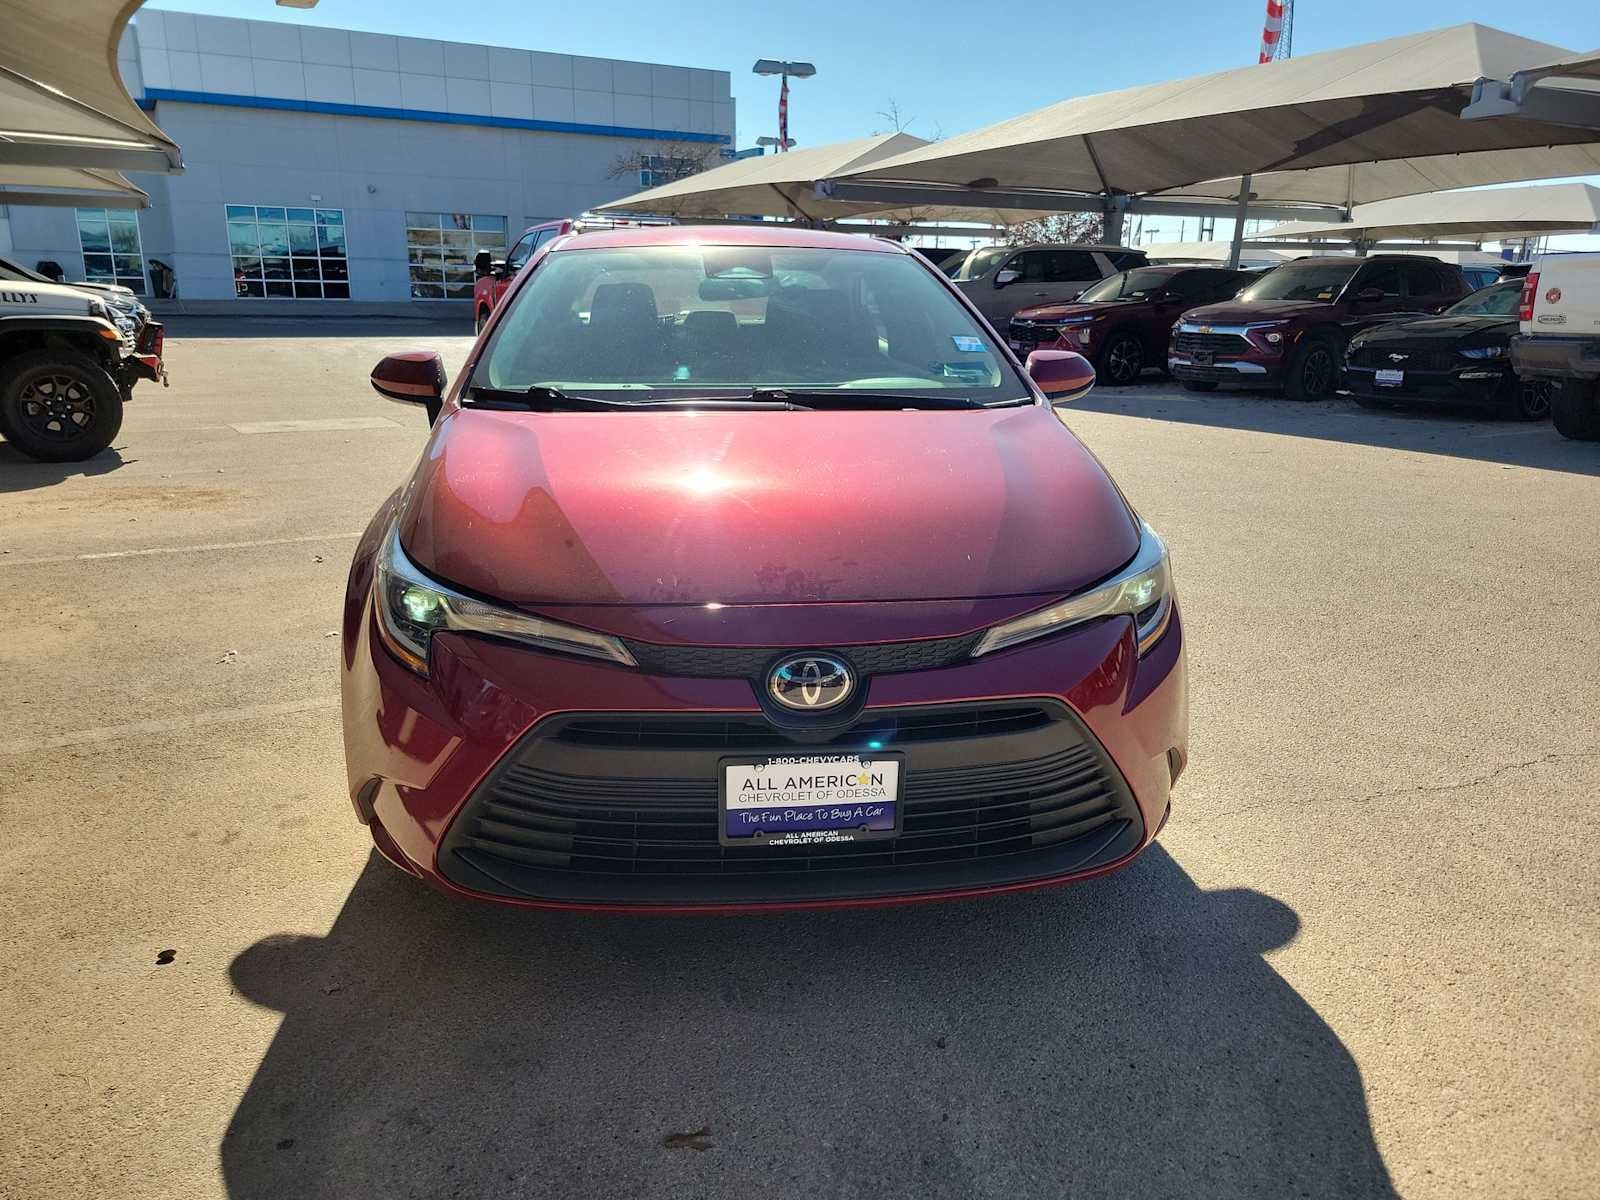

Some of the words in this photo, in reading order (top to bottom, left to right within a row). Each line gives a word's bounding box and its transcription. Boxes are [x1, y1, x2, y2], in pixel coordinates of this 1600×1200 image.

[767, 755, 861, 766] 1-800-CHEVYCARS
[742, 777, 778, 791] ALL
[784, 773, 883, 790] AMERICN
[738, 791, 812, 803] CHEVROLET
[816, 790, 833, 800] OF
[836, 787, 887, 799] ODESSA
[740, 811, 760, 824] The
[761, 811, 782, 823] Fun
[784, 809, 814, 822] Place
[816, 808, 829, 820] To
[830, 808, 853, 822] Buy
[853, 806, 864, 818] A
[865, 805, 885, 817] Car
[769, 837, 812, 846] CHEVROLET
[825, 834, 855, 843] ODESSA
[800, 830, 839, 839] AMERICAN
